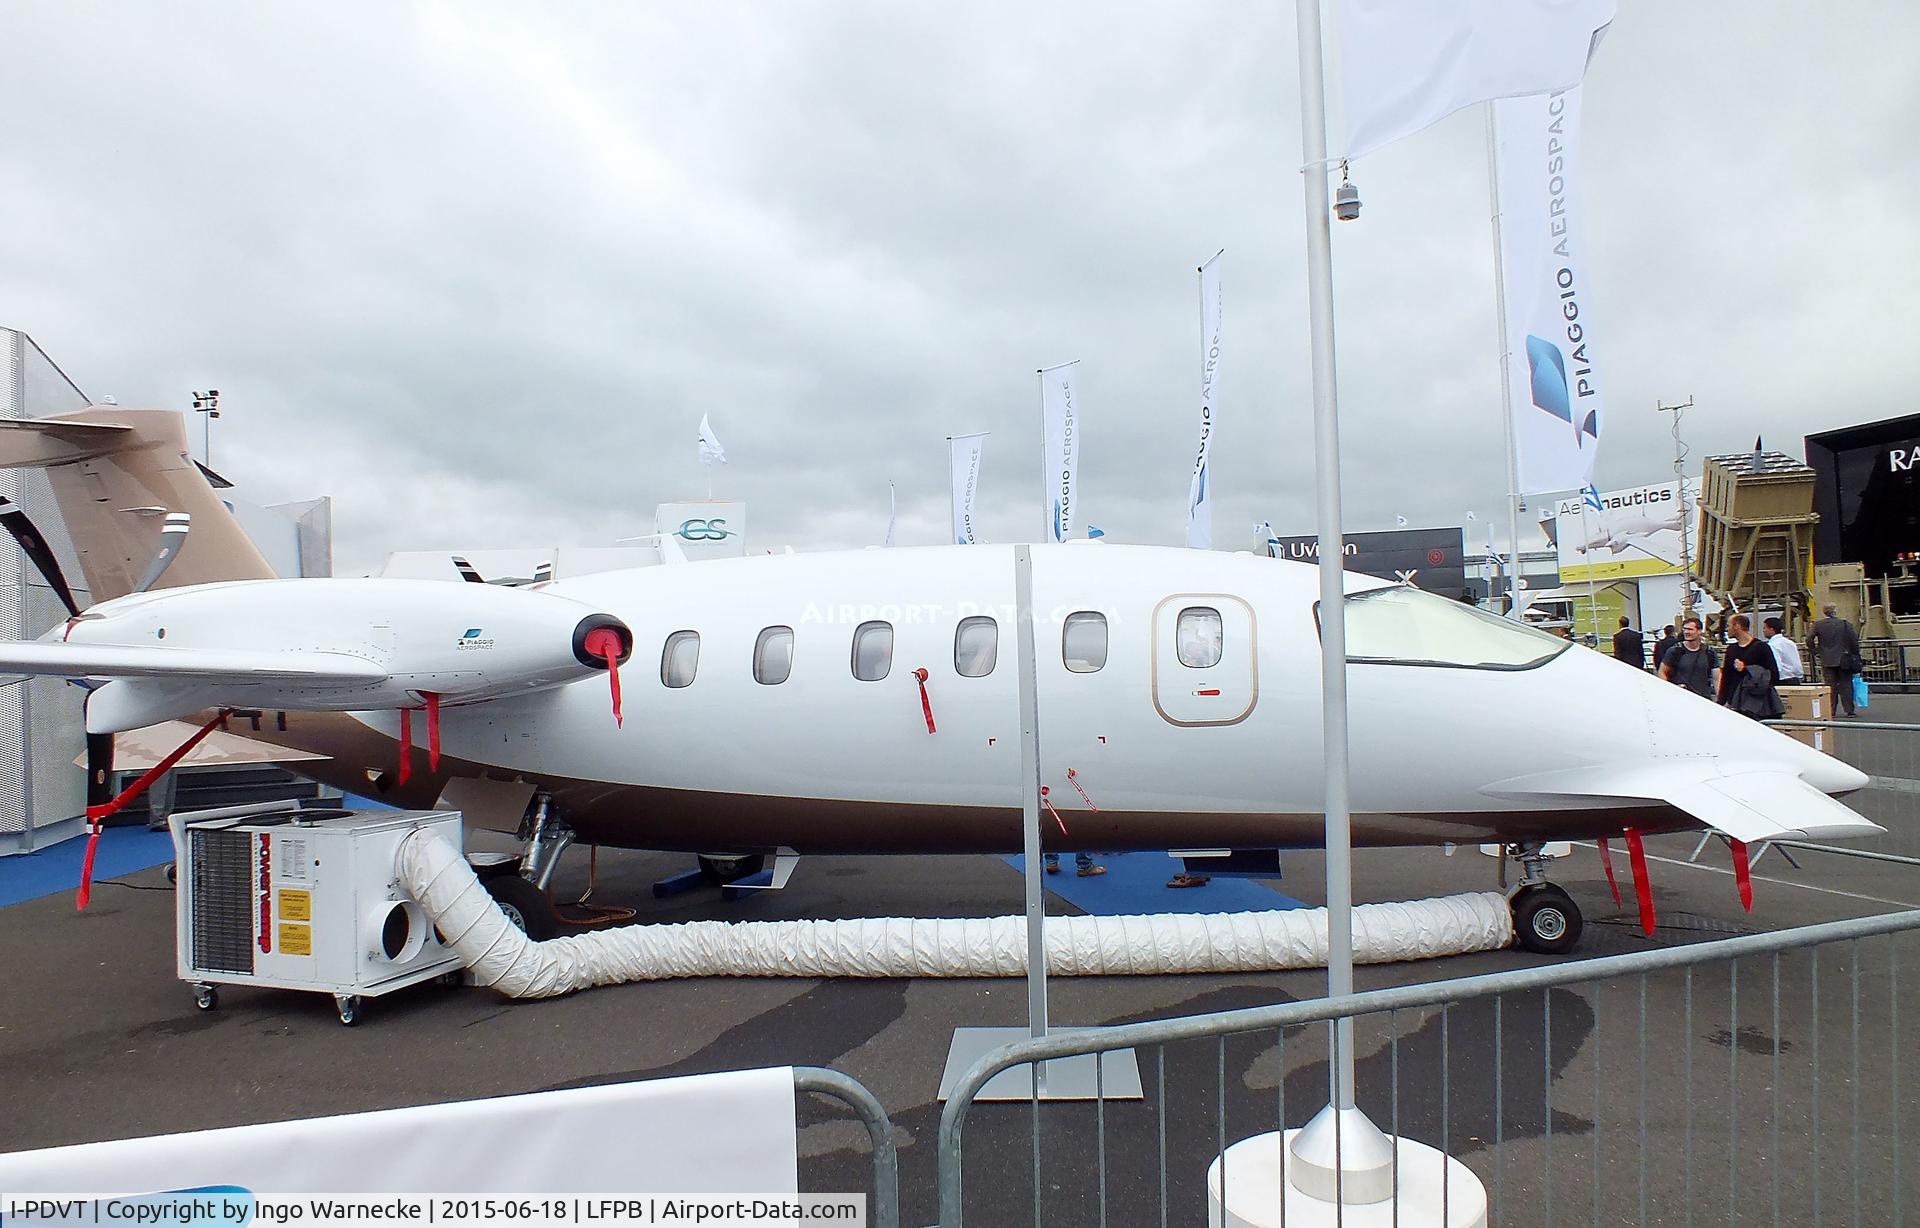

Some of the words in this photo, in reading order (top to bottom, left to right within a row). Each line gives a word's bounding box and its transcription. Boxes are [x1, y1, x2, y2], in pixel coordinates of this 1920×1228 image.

[1556, 267, 1596, 398] PIAGGIO
[1062, 381, 1074, 466] AEROSPACE
[964, 447, 979, 511] AEROSPACE
[1062, 470, 1071, 532] PIAGGIO
[1559, 488, 1671, 516] Aenautics
